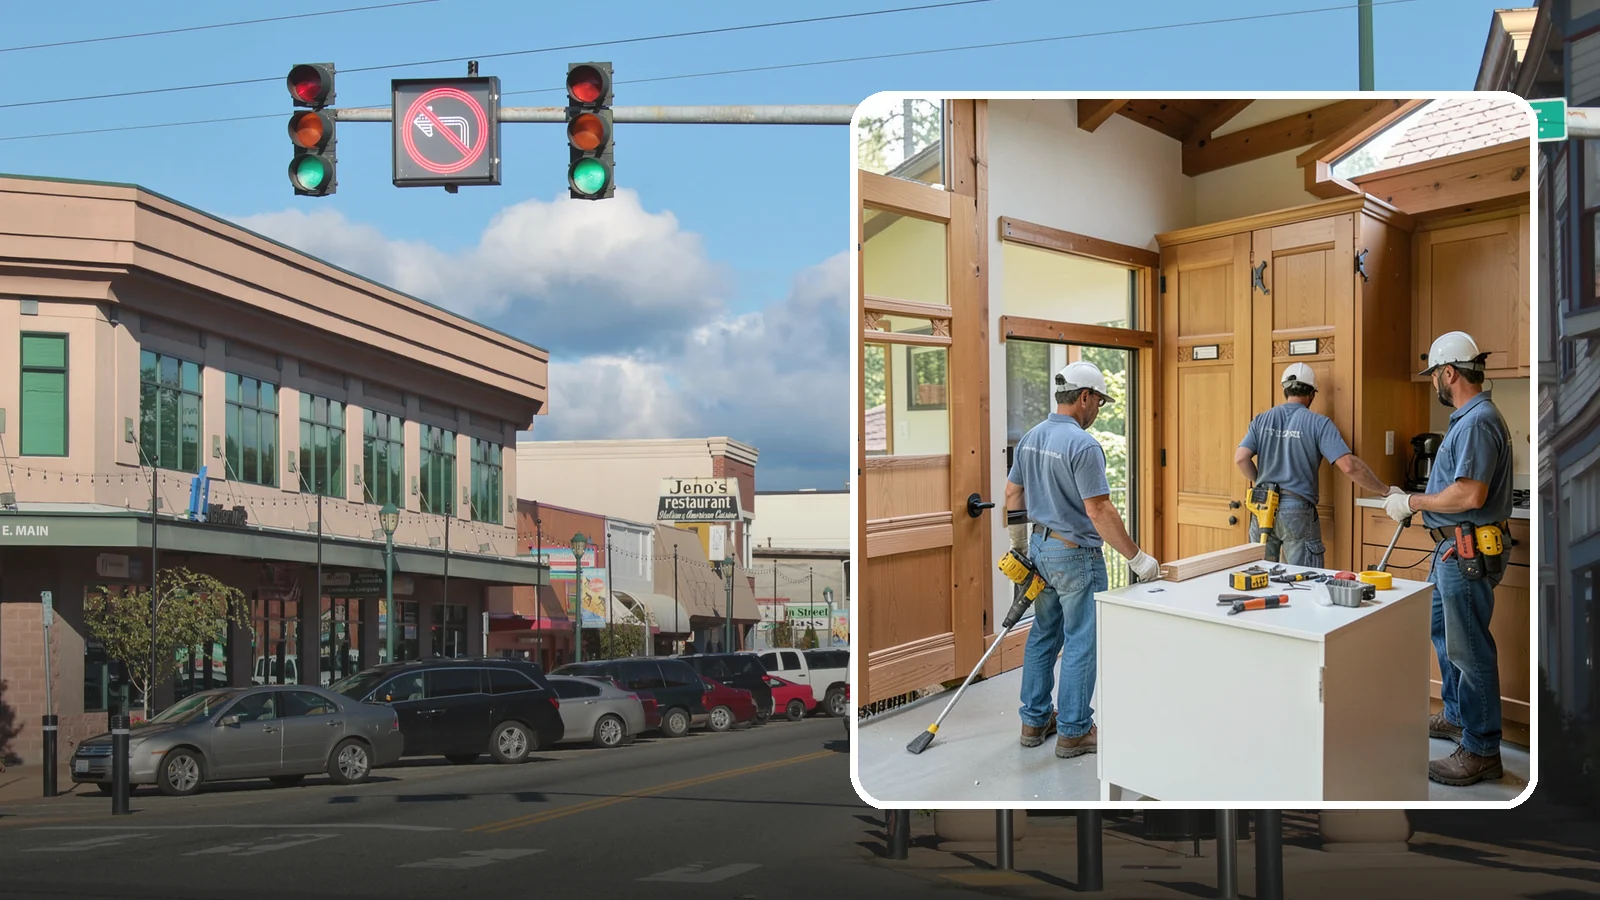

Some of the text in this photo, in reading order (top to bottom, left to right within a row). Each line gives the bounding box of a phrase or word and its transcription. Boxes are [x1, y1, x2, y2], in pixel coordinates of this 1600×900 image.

[670, 480, 727, 495] Jeno's
[665, 496, 731, 509] restaurant
[659, 510, 681, 520] Italian
[686, 510, 714, 520] American
[714, 510, 738, 519] Cuisine
[2, 525, 48, 536] E. MAIN
[797, 607, 828, 616] Street
[791, 619, 823, 627] lass
